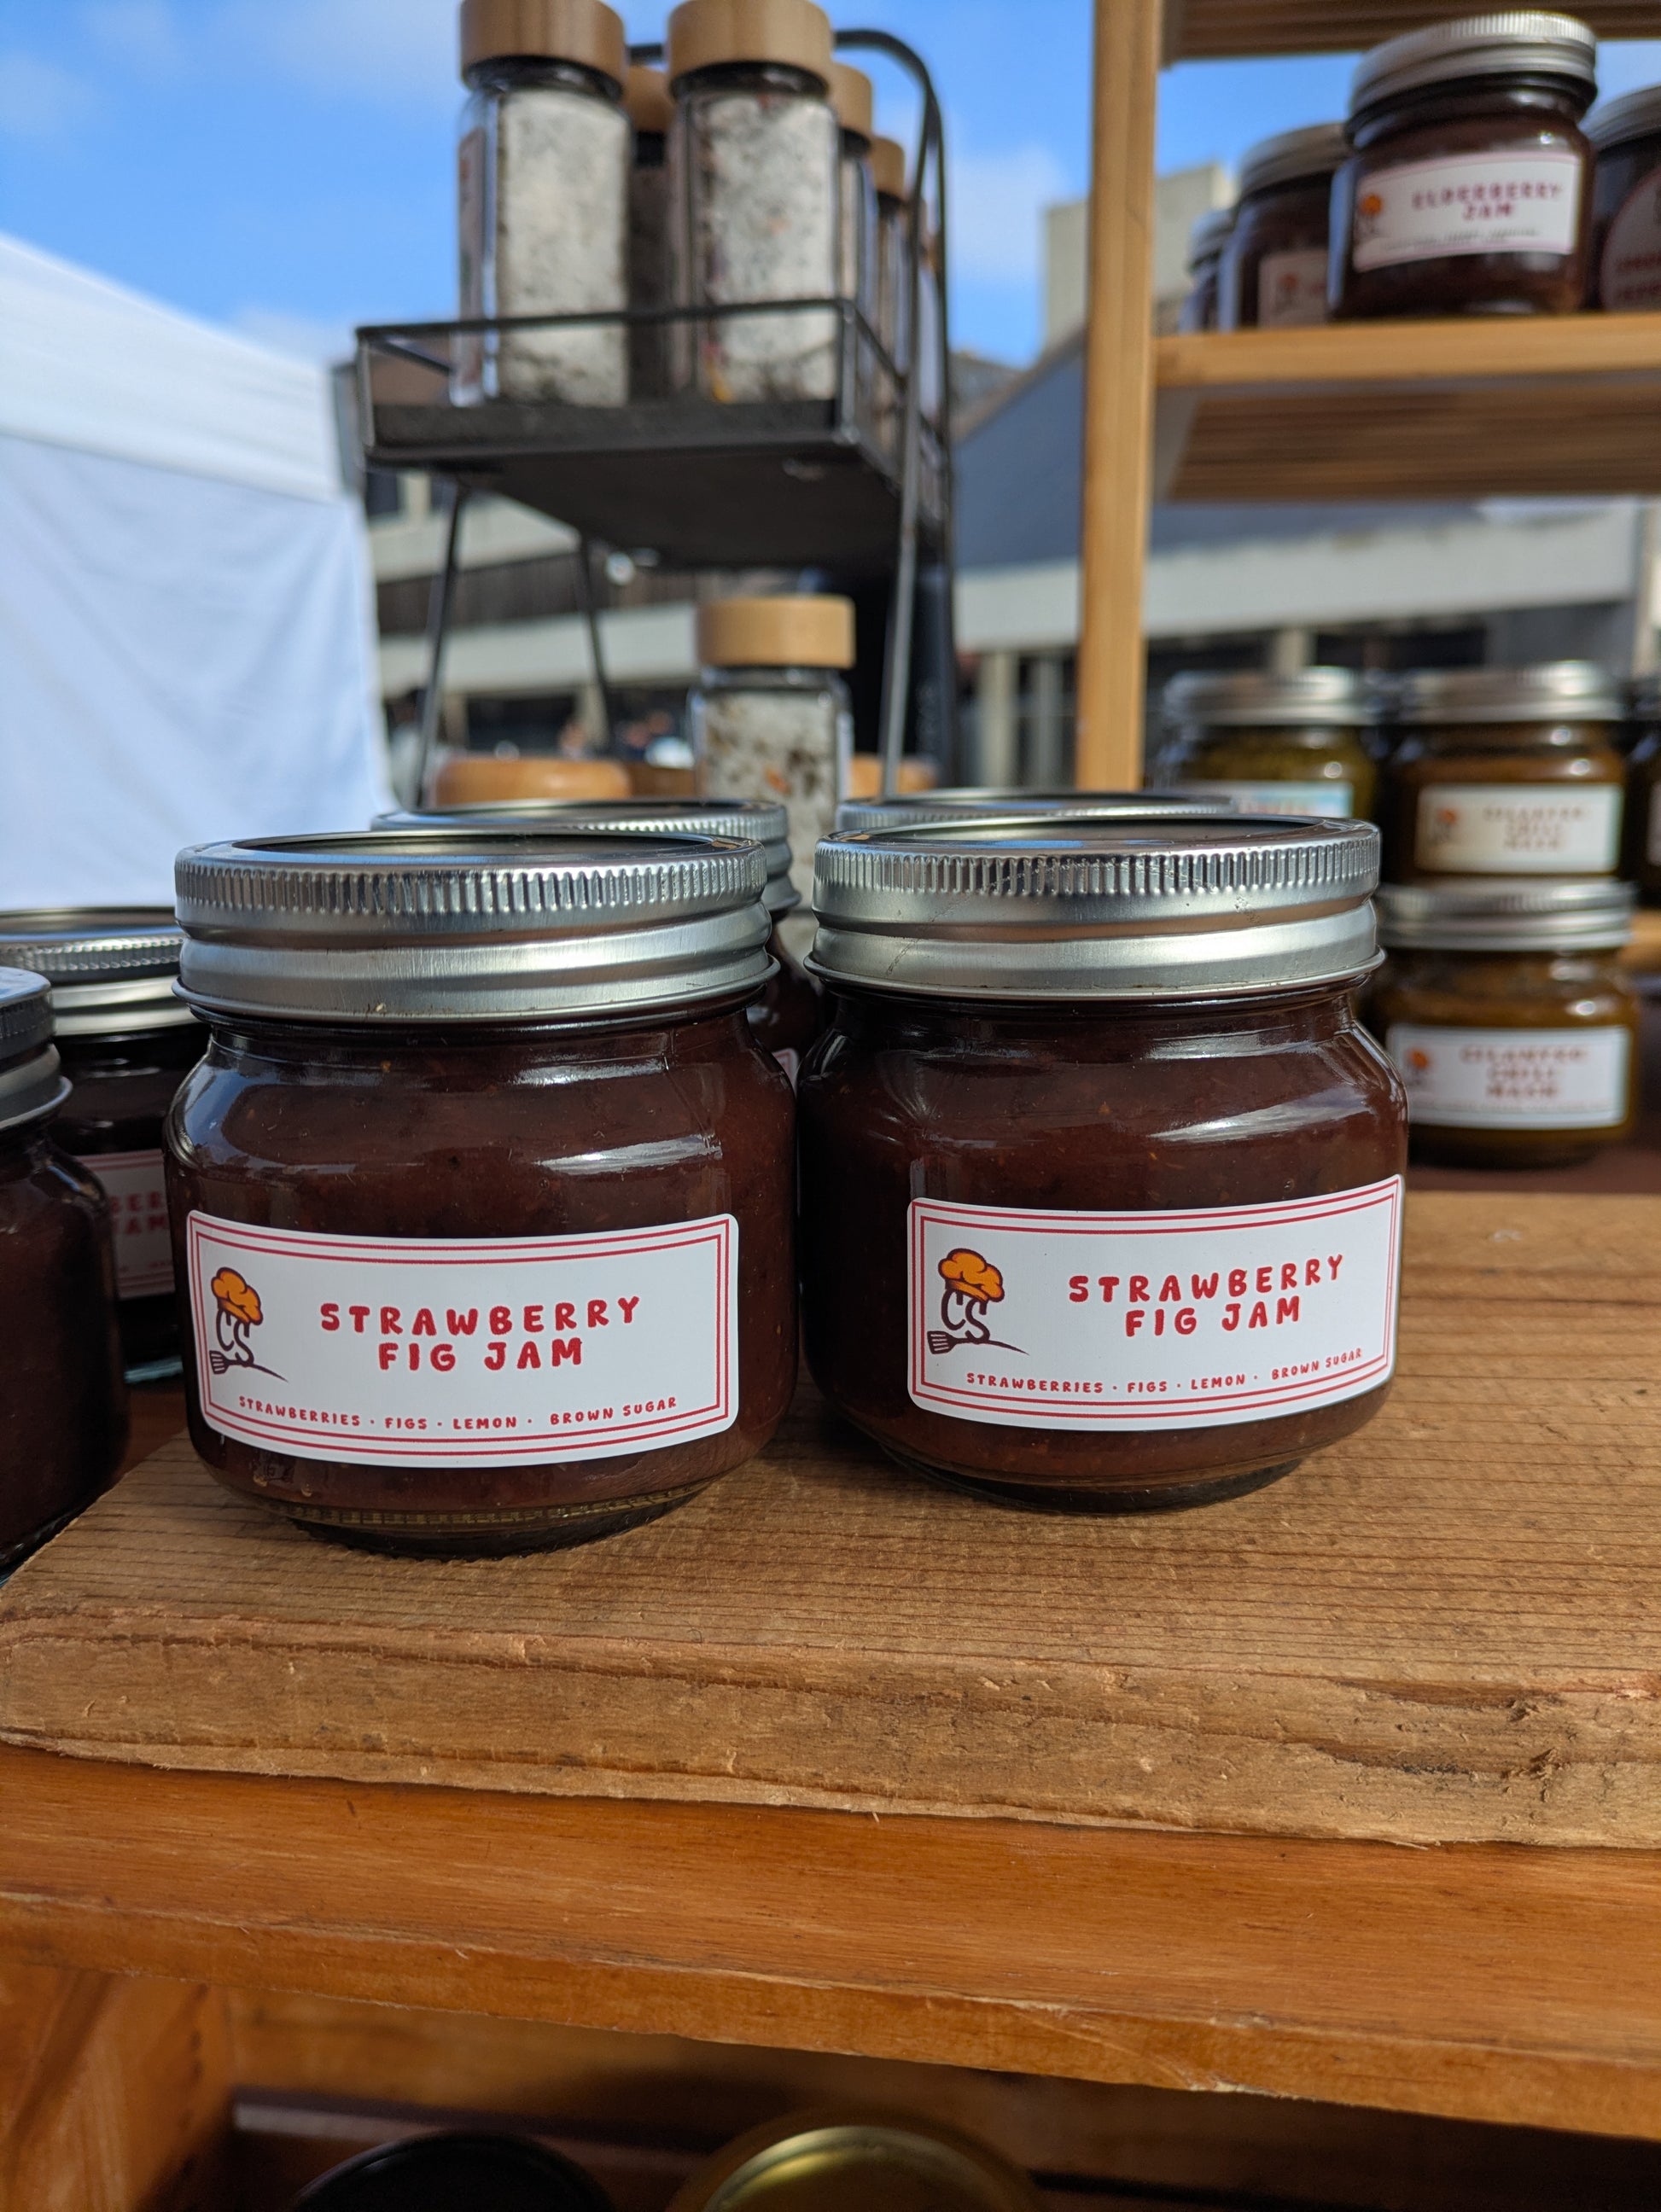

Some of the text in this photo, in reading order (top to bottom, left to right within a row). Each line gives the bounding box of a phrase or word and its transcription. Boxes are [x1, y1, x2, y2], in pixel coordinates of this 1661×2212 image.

[1462, 201, 1513, 222] JAM
[1069, 1254, 1343, 1303] STRAWBERRY
[320, 1295, 640, 1337] STRAWBERRY
[1125, 1295, 1301, 1337] FIG JAM
[377, 1336, 583, 1372] FIG JAM
[966, 1348, 1362, 1394] STRAWBERRIES FIGS LEMON BROWN SUGAR
[238, 1395, 677, 1430] STRAWBERRIES FIGS LEMON BROWN SUGAR
